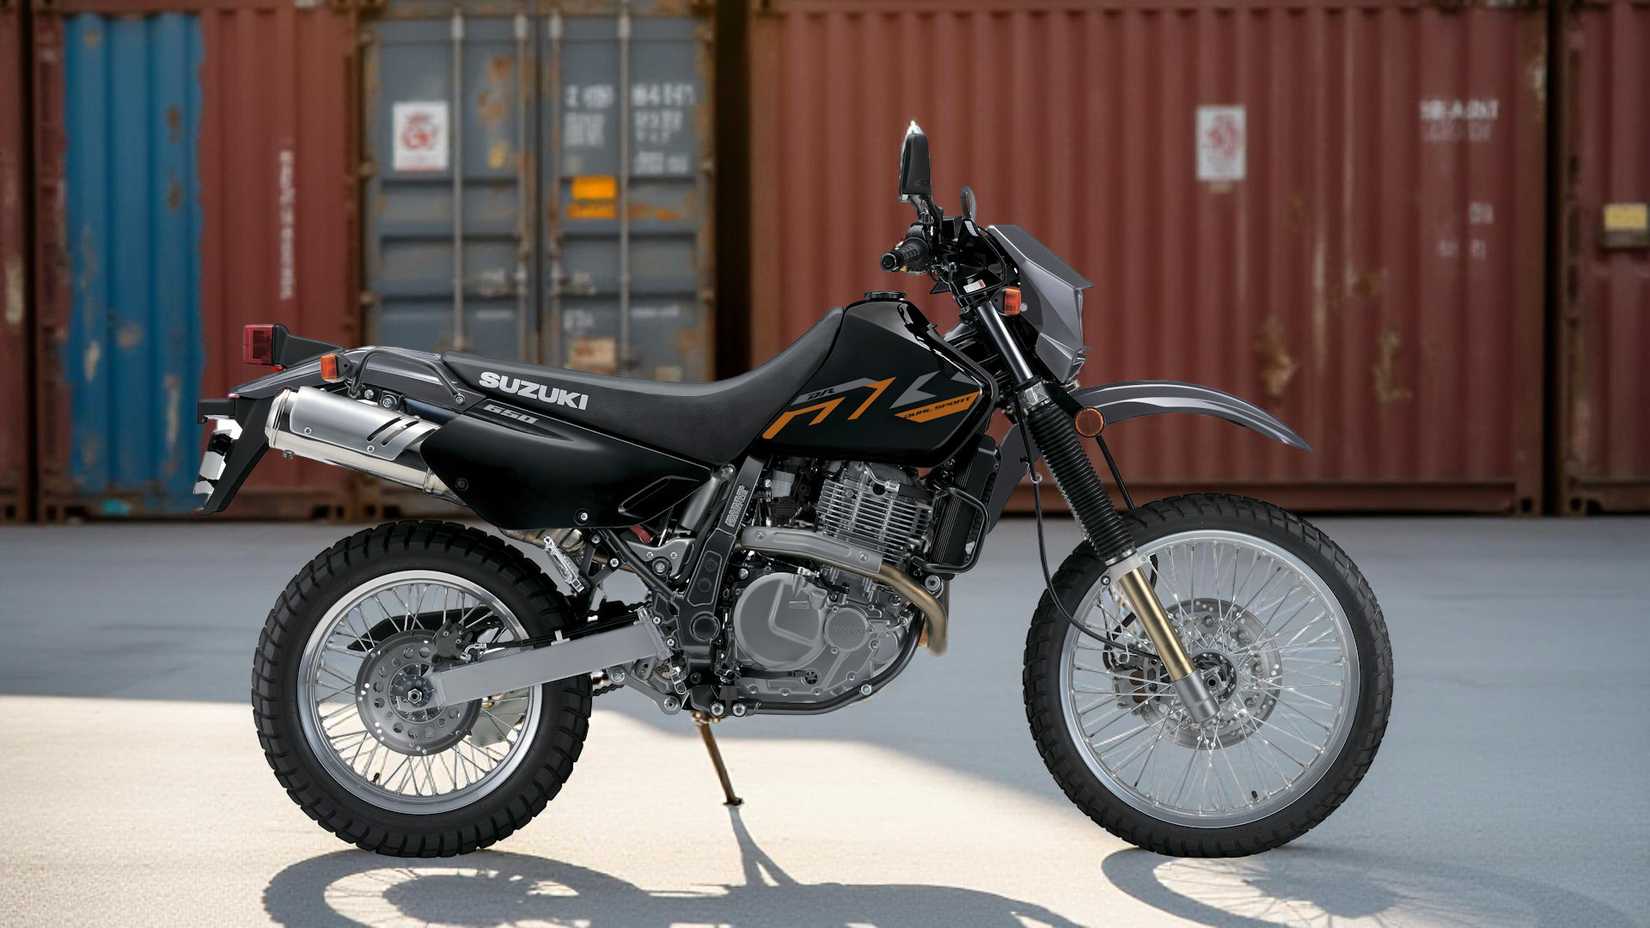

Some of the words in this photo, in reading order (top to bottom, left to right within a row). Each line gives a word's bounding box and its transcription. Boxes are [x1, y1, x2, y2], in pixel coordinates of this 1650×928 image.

[479, 371, 589, 411] SUZUKI
[483, 403, 539, 424] 650
[934, 396, 970, 410] SPORT
